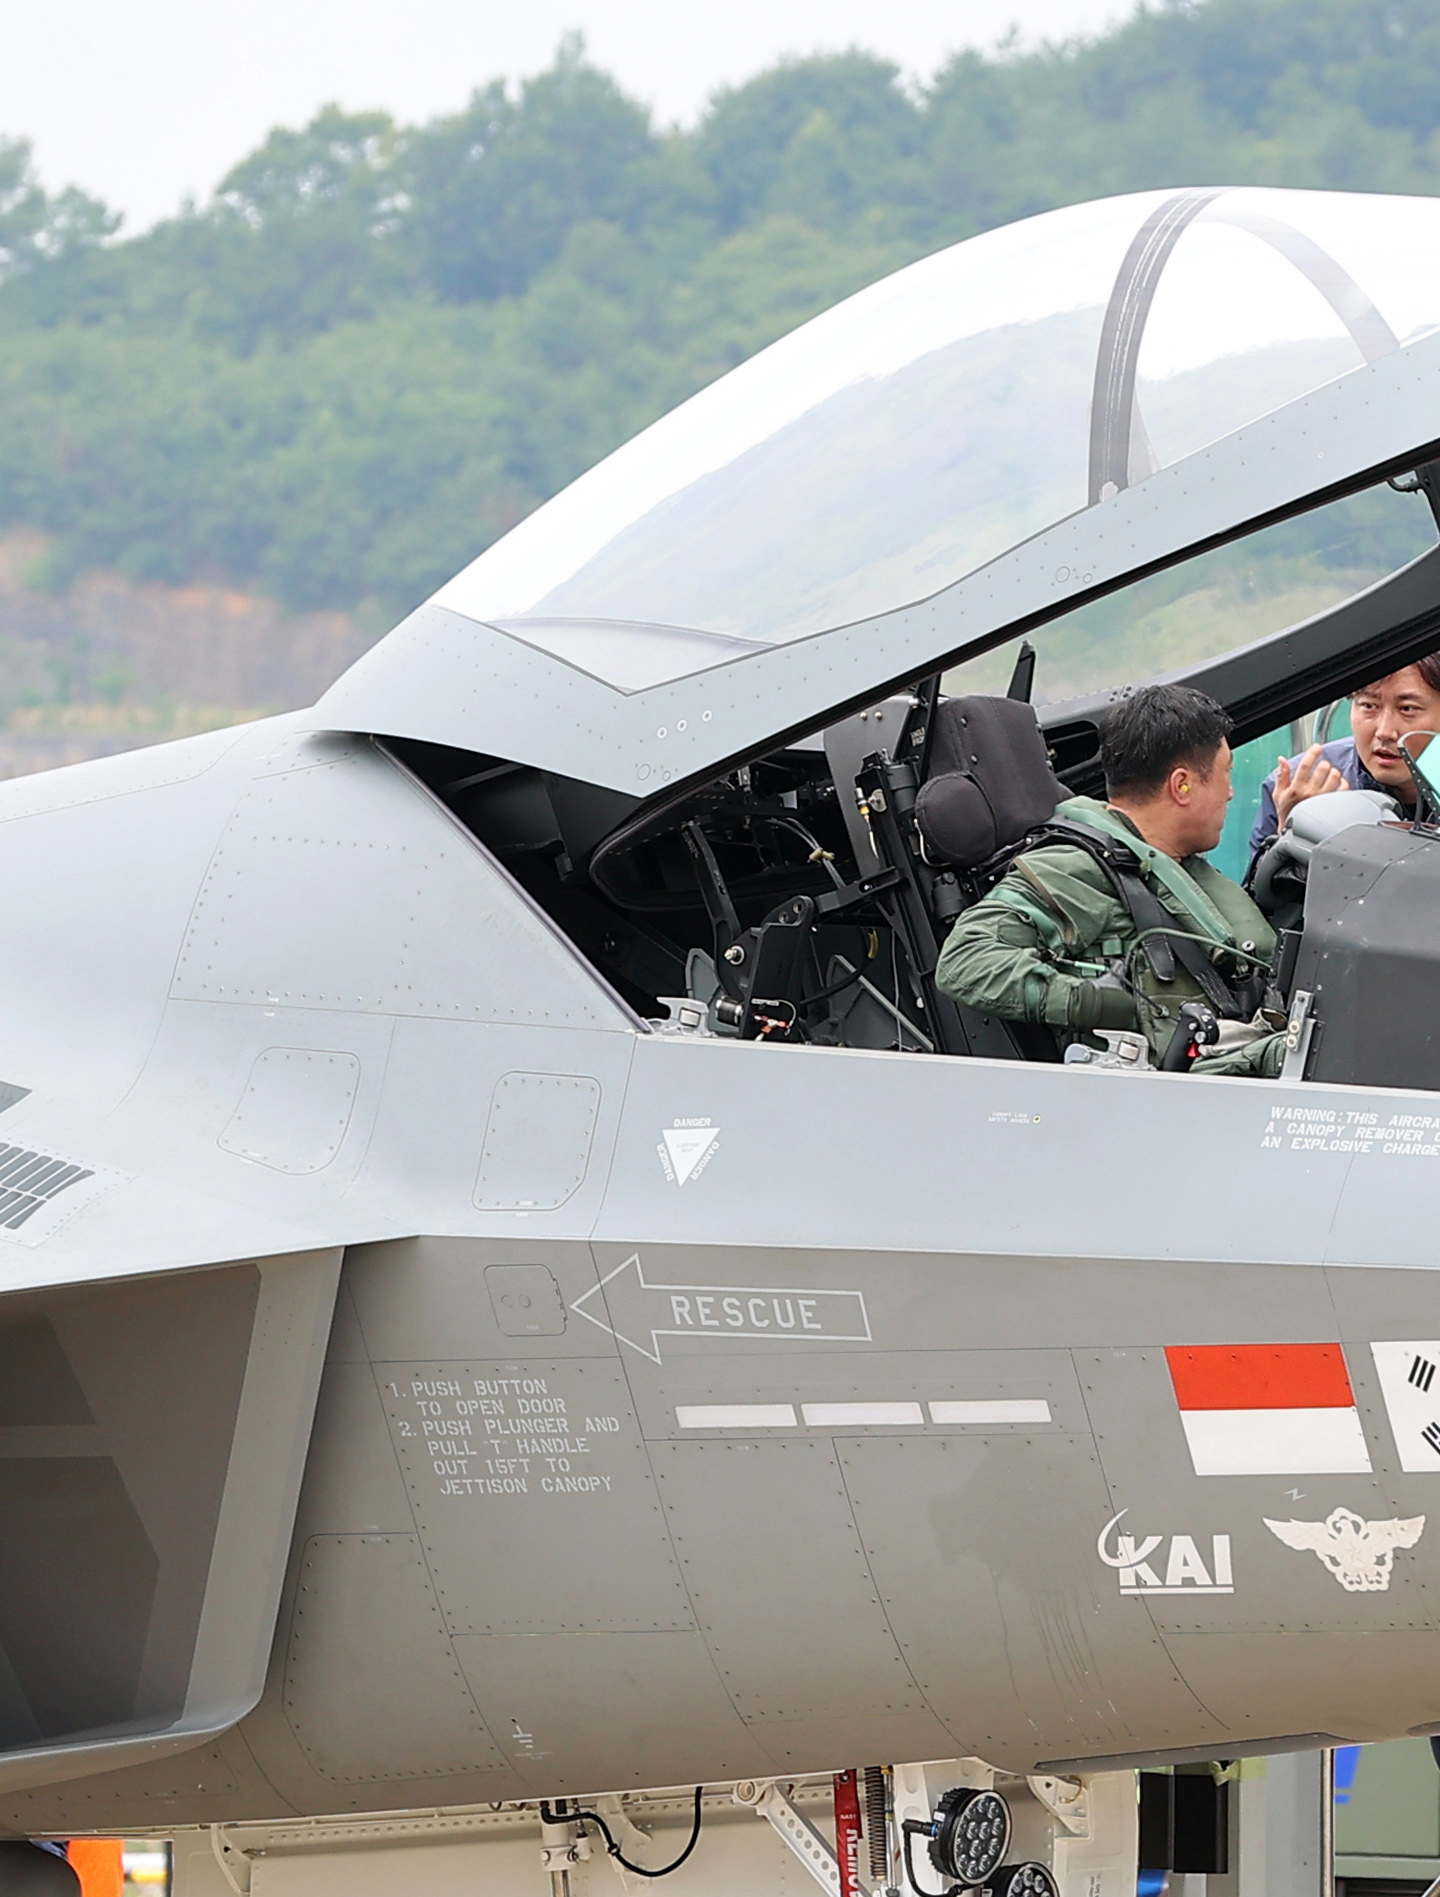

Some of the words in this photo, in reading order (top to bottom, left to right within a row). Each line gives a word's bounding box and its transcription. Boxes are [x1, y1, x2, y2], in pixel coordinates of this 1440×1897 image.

[673, 1117, 711, 1127] DANGER
[1265, 1121, 1275, 1134] A
[1286, 1122, 1346, 1138] CANOPY
[1354, 1126, 1424, 1142] REMOVER
[1260, 1135, 1282, 1149] AN
[1290, 1137, 1374, 1153] EXPLOSIVE
[656, 1142, 675, 1182] DANGER
[690, 1140, 720, 1181] DANGER
[670, 1295, 822, 1329] RESCUE
[390, 1382, 406, 1397] 1.
[411, 1381, 461, 1397] PUSH
[474, 1379, 547, 1396] BUTTON
[416, 1401, 442, 1416] TO
[456, 1399, 504, 1415] OPEN
[517, 1398, 566, 1414] DOOR
[399, 1421, 417, 1437] 2.
[422, 1420, 472, 1436] PUSH
[484, 1418, 569, 1435] PLUNGER
[585, 1416, 620, 1433] AND
[428, 1440, 477, 1456] PULL
[516, 1438, 590, 1454] HANDLE
[433, 1459, 468, 1475] OUT
[486, 1458, 530, 1474] 15FT
[545, 1457, 570, 1473] TO
[440, 1478, 528, 1495] JETTISON
[541, 1476, 611, 1492] CANOPY
[1098, 1510, 1233, 1587] KAI
